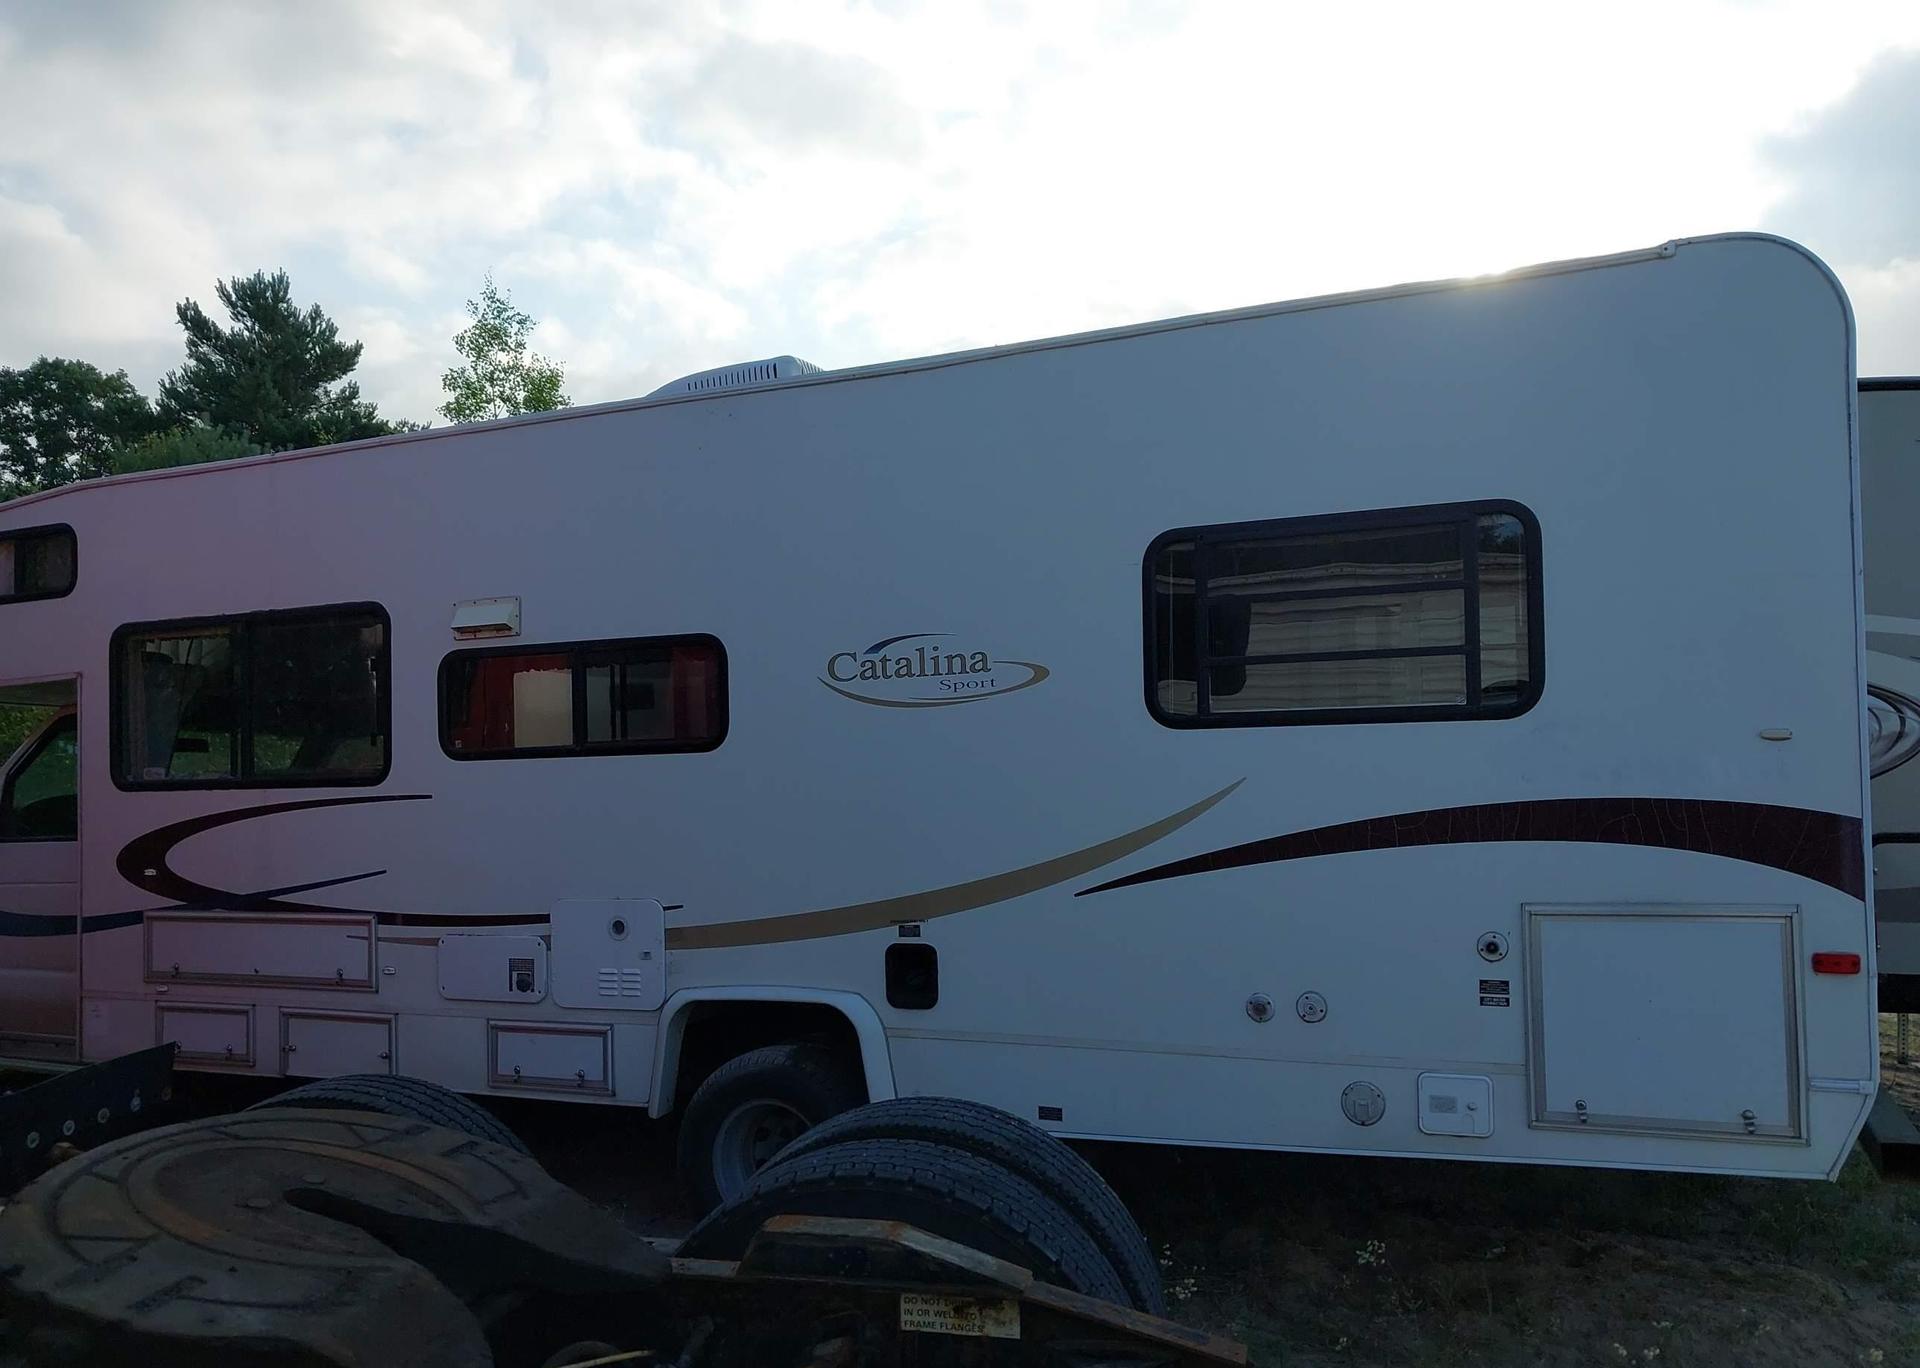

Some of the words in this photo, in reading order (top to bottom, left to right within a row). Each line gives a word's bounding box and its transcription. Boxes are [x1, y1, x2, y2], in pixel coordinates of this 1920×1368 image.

[827, 646, 992, 683] Catalina
[939, 677, 997, 693] Sport
[903, 1296, 918, 1305] DO
[920, 1297, 941, 1306] NOT
[903, 1308, 914, 1317] IN
[916, 1308, 930, 1317] OR
[903, 1320, 937, 1329] FRAME
[939, 1322, 985, 1333] FLANGES
